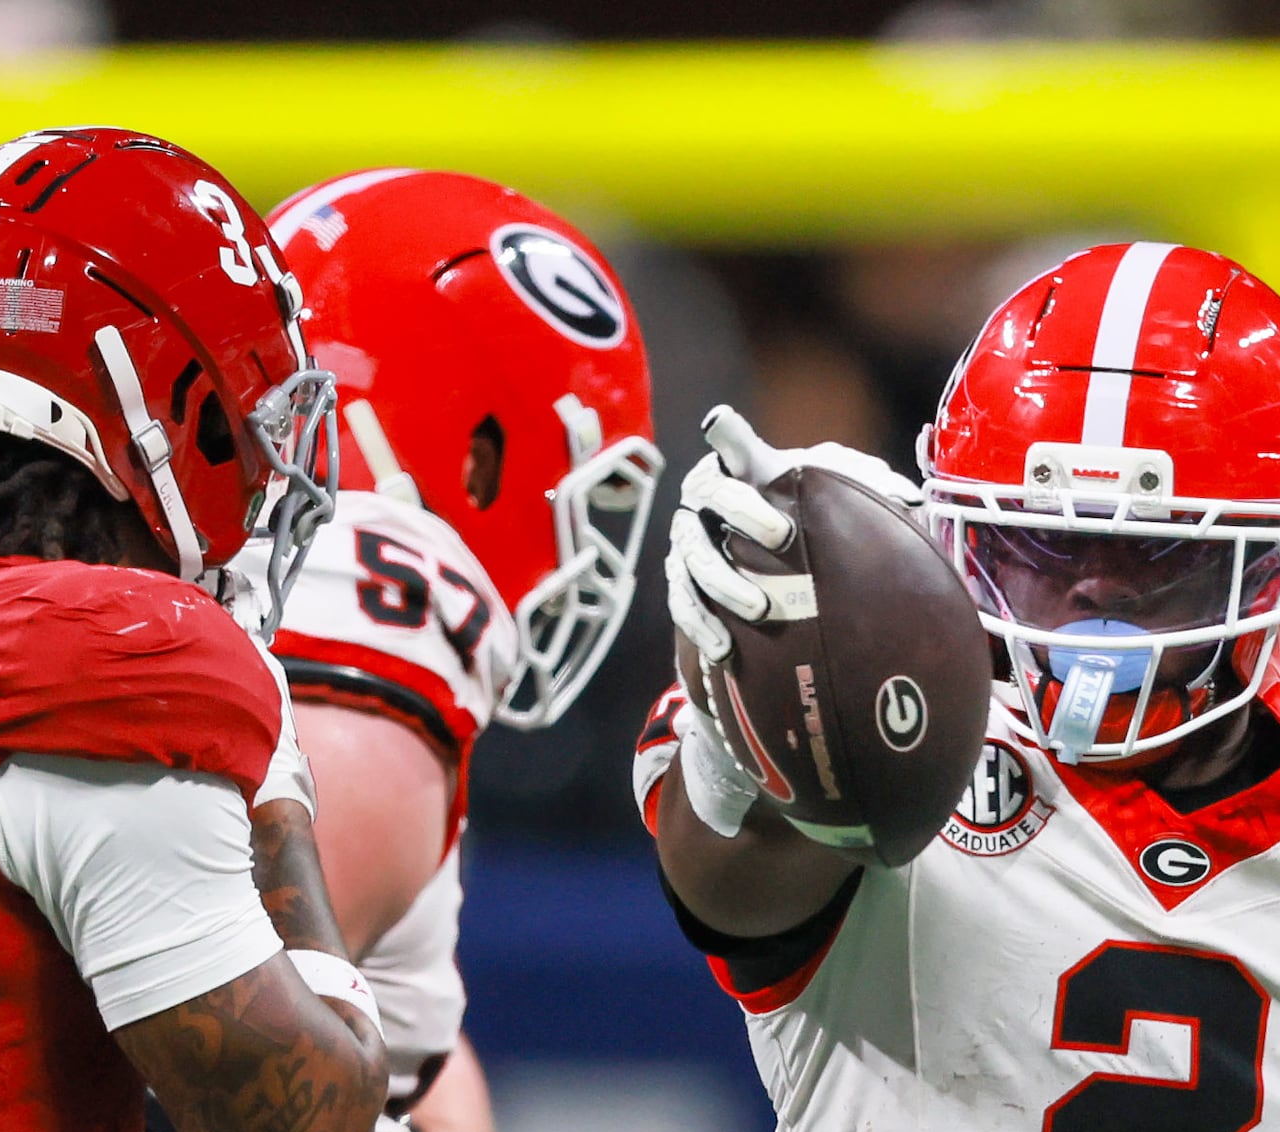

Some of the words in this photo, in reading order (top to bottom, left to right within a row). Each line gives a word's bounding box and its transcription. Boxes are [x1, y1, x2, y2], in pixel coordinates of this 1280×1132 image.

[193, 179, 258, 287] 3
[496, 227, 622, 346] G
[354, 526, 492, 673] 57
[878, 677, 926, 750] G
[950, 744, 1024, 826] EC
[942, 819, 1037, 852] RADUATE
[1140, 839, 1210, 885] G
